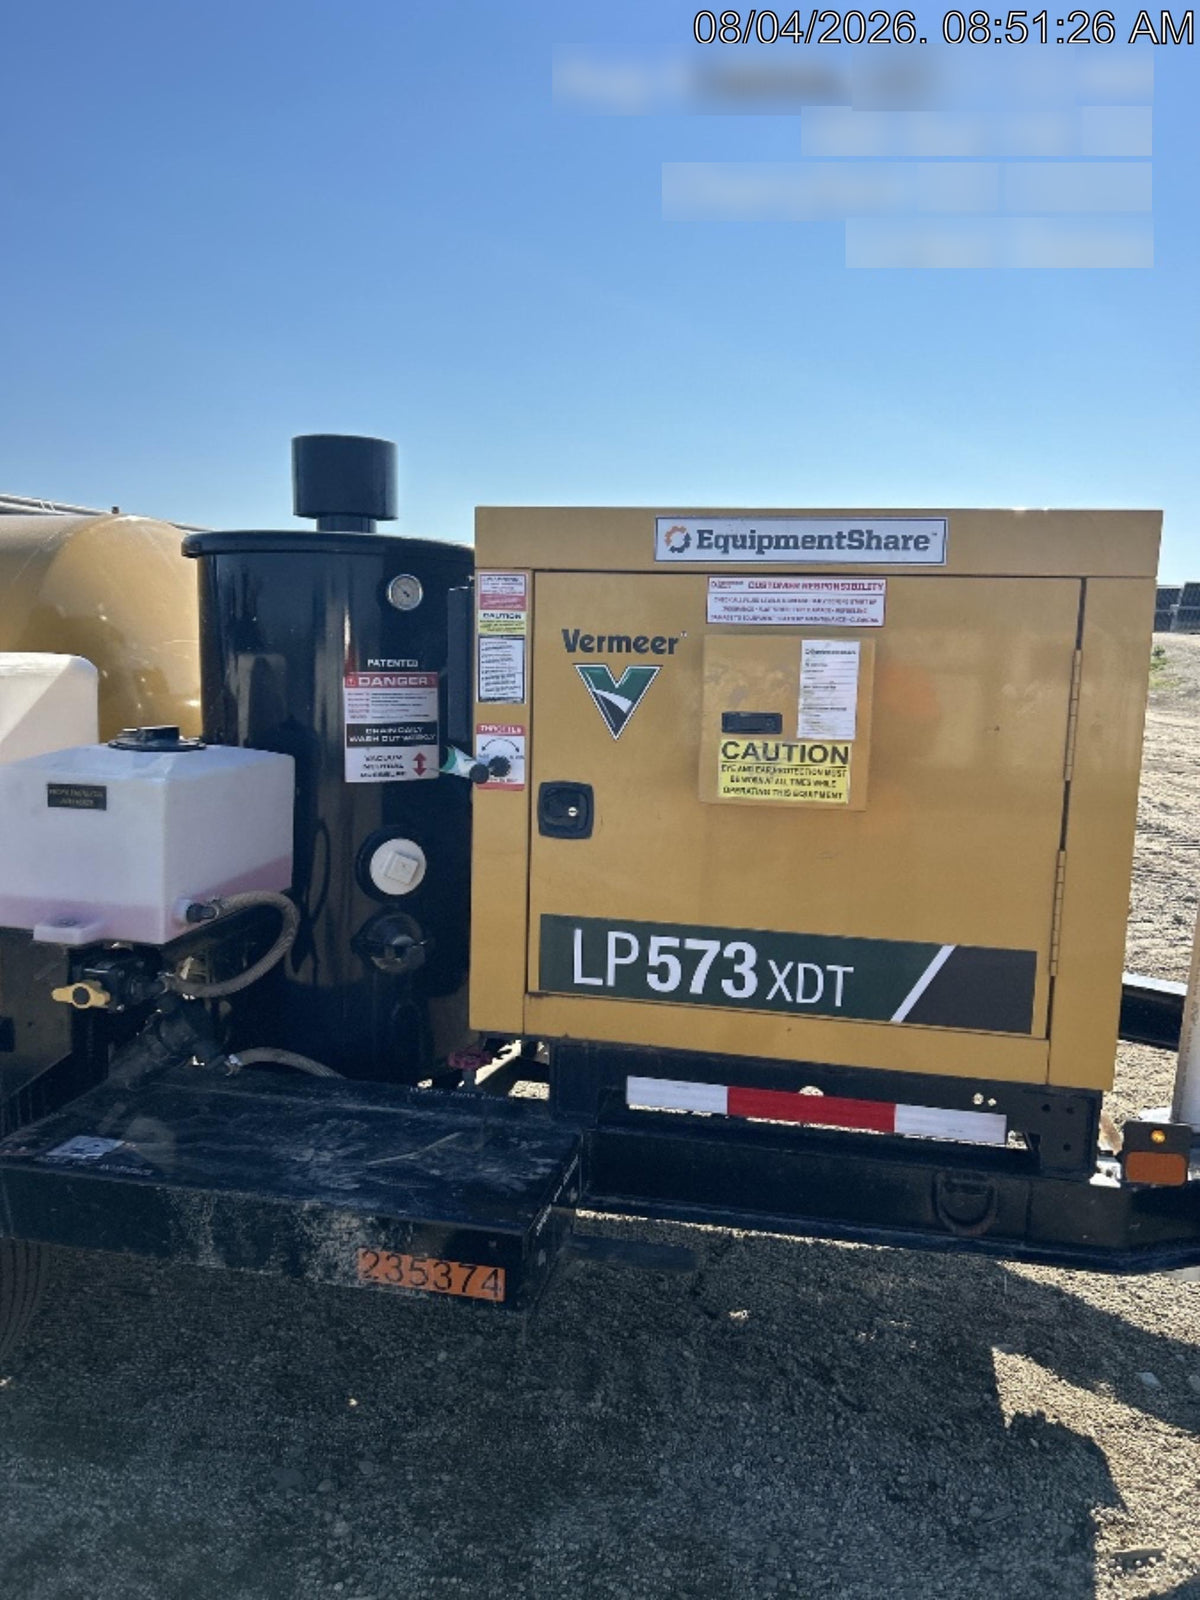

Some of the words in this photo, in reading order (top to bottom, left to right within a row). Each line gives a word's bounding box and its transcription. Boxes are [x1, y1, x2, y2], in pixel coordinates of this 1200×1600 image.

[696, 529, 931, 555] EquipmentShare
[561, 629, 680, 655] Vermeer
[367, 658, 419, 668] PATENTED
[358, 676, 428, 687] DANGER
[721, 740, 849, 765] CAUTION
[361, 1250, 503, 1298] 235374
